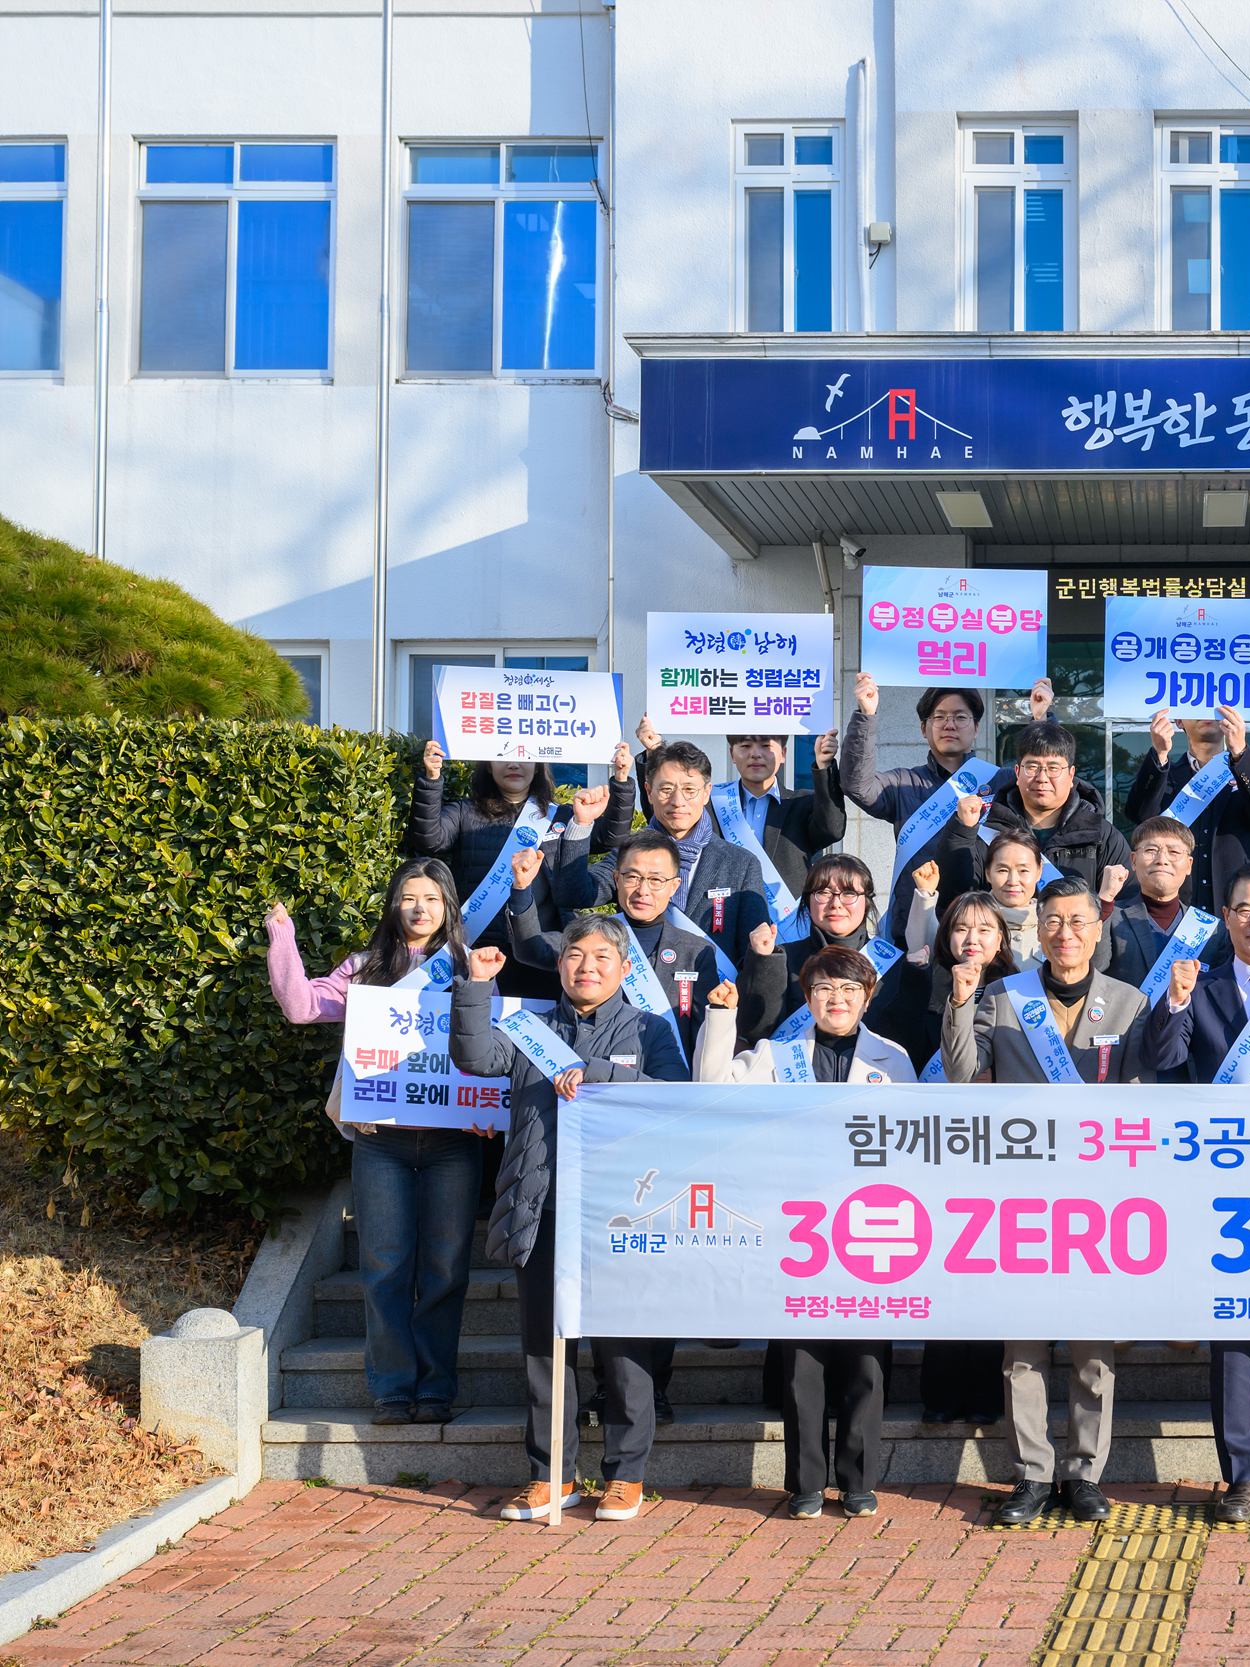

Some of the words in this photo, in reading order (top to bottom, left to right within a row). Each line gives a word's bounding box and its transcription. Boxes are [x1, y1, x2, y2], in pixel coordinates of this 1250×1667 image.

[1061, 389, 1217, 451] 행복한
[792, 446, 973, 459] NAMHAE
[1055, 576, 1247, 598] 군민행복법률상담실
[754, 631, 798, 657] 남해
[917, 640, 987, 677] 멀리
[659, 667, 739, 688] 함께하는
[745, 668, 821, 688] 청렴실천
[460, 691, 512, 711] 갑질은
[517, 694, 577, 713] 빼고(-)
[669, 695, 747, 716] 신뢰받는
[753, 696, 812, 717] 남해군
[461, 715, 513, 735] 존중은
[518, 718, 597, 738] 더하고(+)
[389, 1007, 435, 1036] 청렴
[355, 1047, 399, 1072] 부패
[407, 1051, 450, 1075] 앞에
[353, 1079, 397, 1103] 군민
[405, 1083, 449, 1107] 앞에
[845, 1114, 1057, 1166] 함께해요!
[610, 1232, 668, 1254] 남해군
[675, 1235, 762, 1247] NAMHAE
[943, 1196, 1168, 1276] ZERO
[784, 1295, 932, 1320] 부정·부실·부당
